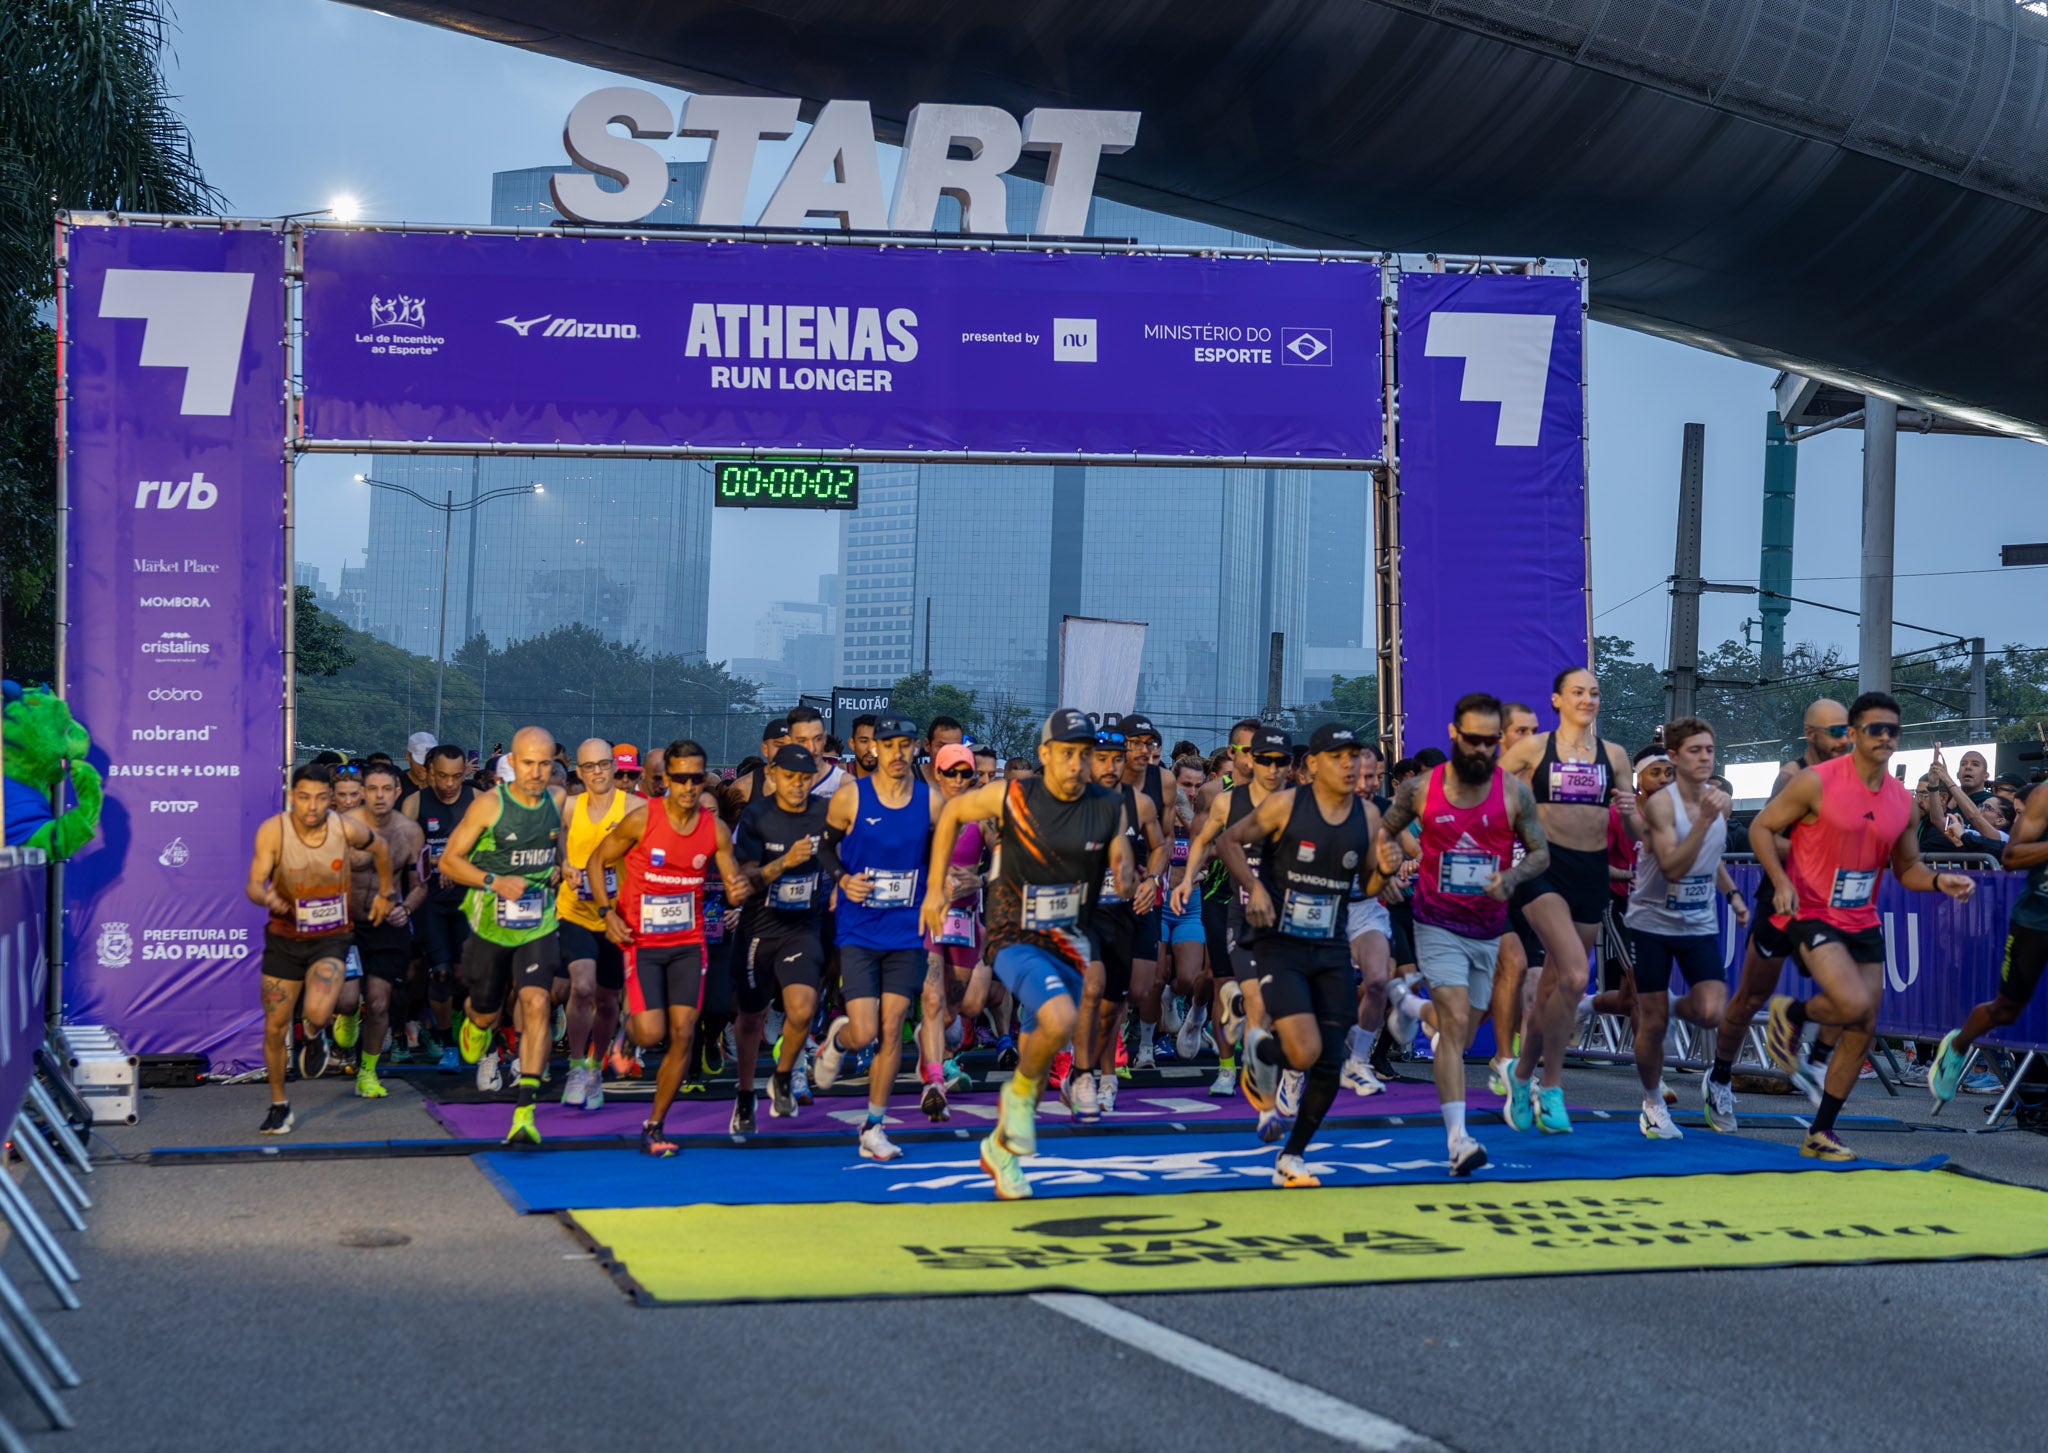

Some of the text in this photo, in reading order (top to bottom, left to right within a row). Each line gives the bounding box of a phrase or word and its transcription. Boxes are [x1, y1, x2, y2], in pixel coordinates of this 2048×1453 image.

[549, 86, 1142, 237] START
[684, 303, 919, 363] ATHENAS
[961, 331, 1040, 346] presented by
[1144, 322, 1272, 342] MINISTÉRIO DO
[355, 334, 445, 346] Lei de Incentivo
[371, 347, 386, 355] ao
[1194, 347, 1272, 364] ESPORTE
[711, 366, 893, 392] RUN LONGER
[721, 467, 854, 498] 00:00:02
[134, 472, 218, 510] rvb
[133, 558, 220, 574] Market Place
[139, 596, 211, 608] MOMBORA
[141, 640, 210, 654] cristalins
[147, 687, 203, 701] dobro
[838, 695, 889, 711] PELOTÃO
[1567, 774, 1596, 788] 7825
[1468, 866, 1476, 878] 7
[888, 881, 901, 893] 16
[1684, 884, 1708, 897] 1220
[1856, 881, 1866, 893] 71
[518, 902, 531, 912] 57
[1048, 896, 1068, 911] 116
[311, 906, 337, 919] 6223
[661, 906, 682, 917] 955
[1307, 908, 1322, 920] 58
[954, 918, 961, 930] 6
[143, 928, 248, 941] PREFEITURA DE
[142, 942, 248, 960] SÃO PAULO
[1414, 1195, 1665, 1212] mais
[1448, 1210, 1641, 1225] que
[1491, 1219, 1731, 1236] uma
[900, 1229, 1435, 1257] IGUANA
[1530, 1224, 1961, 1248] corrida
[916, 1242, 1466, 1270] SPORTS
